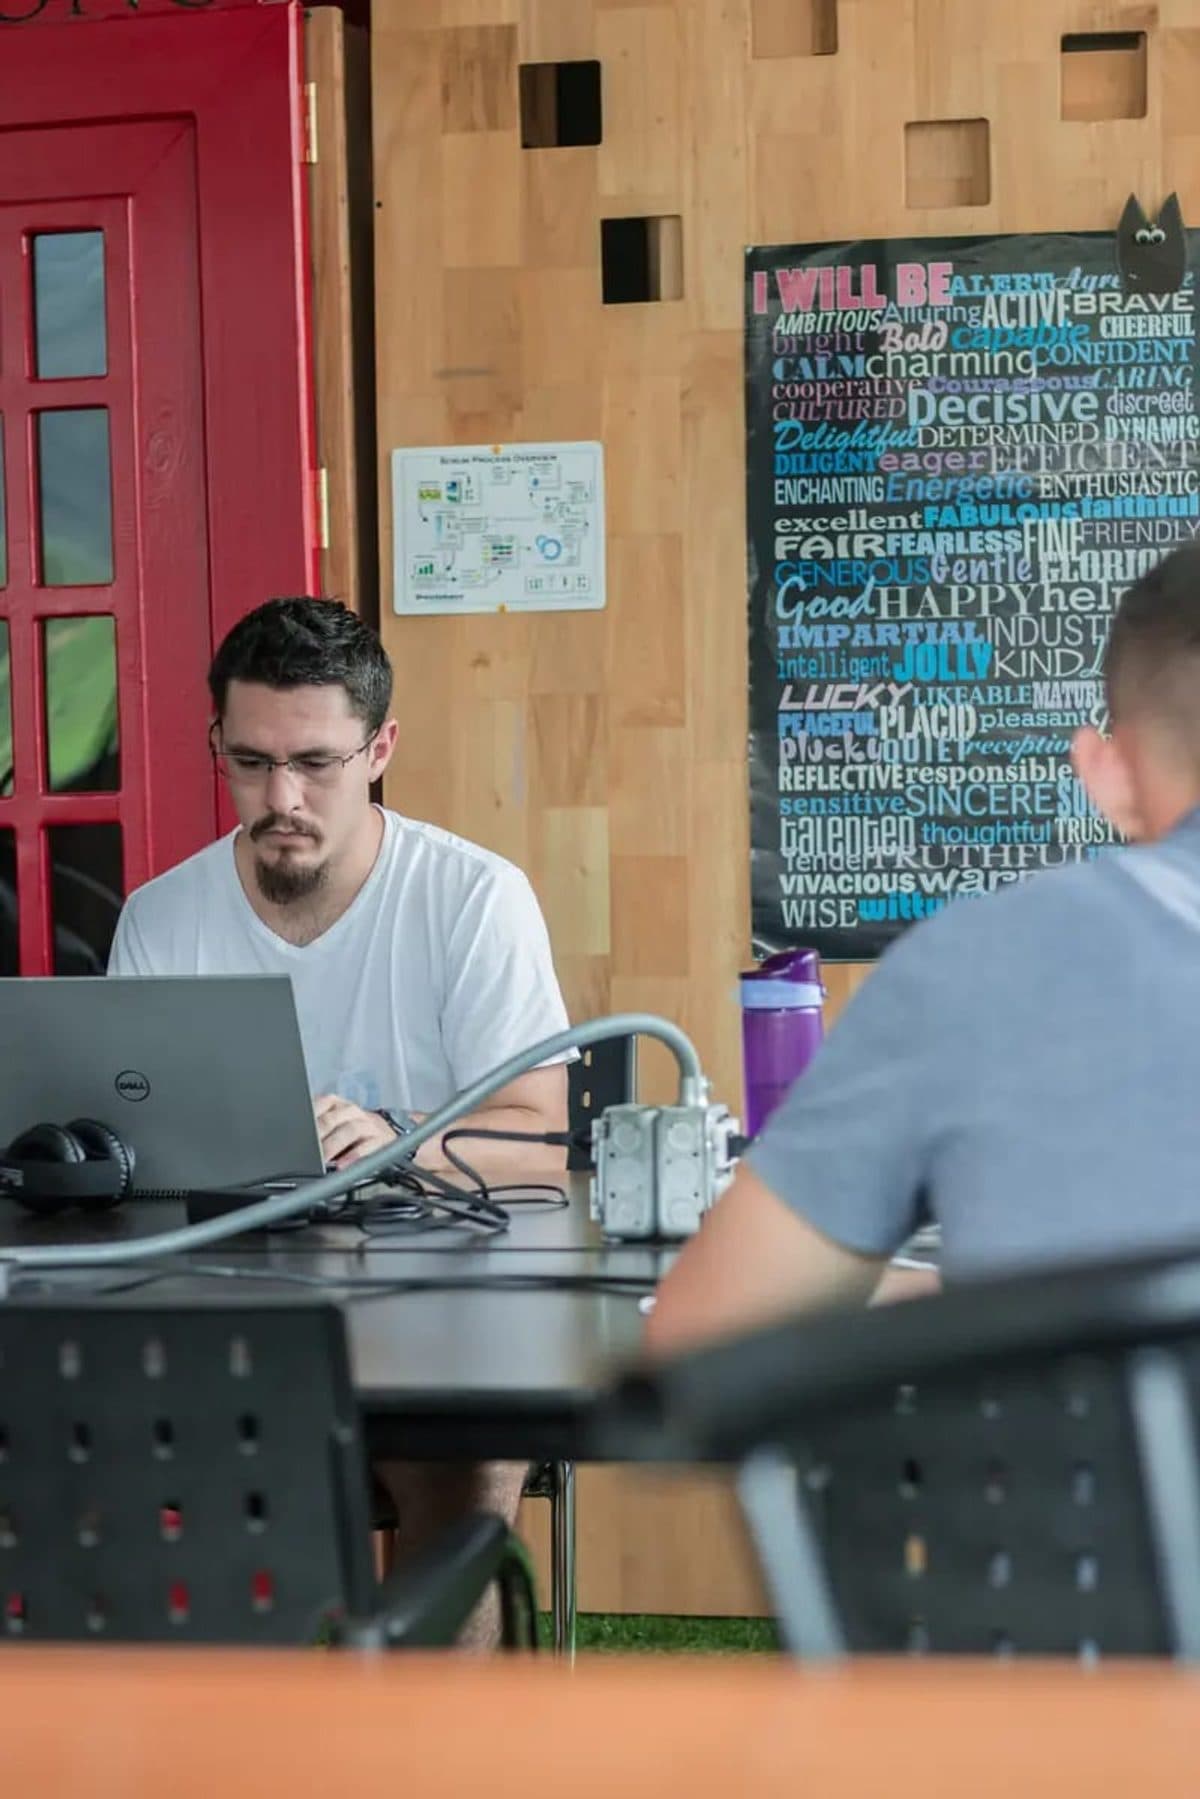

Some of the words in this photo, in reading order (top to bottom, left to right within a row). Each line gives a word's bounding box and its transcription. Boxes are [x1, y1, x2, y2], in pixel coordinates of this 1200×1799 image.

[753, 271, 769, 314] I
[776, 264, 887, 313] WILL
[896, 262, 954, 307] BE
[949, 272, 1056, 296] ALERT
[775, 310, 884, 335] AMBITIOUS
[882, 302, 983, 329] Alluring
[982, 289, 1073, 329] ACTIVE
[1073, 290, 1196, 315] BRAVE
[772, 326, 865, 358] bright
[877, 320, 949, 353] Bold
[951, 318, 1091, 355] capable
[1100, 313, 1196, 339] CHEERFUL
[772, 354, 866, 380] CALM
[865, 347, 1037, 380] charming
[1031, 339, 1196, 366] CONFIDENT
[772, 377, 922, 406] cooperative
[1092, 365, 1195, 389] CARING
[773, 397, 907, 421] CULTURED
[908, 389, 1099, 426] Decisive
[1106, 386, 1195, 415] discreet
[774, 419, 919, 457] Delightful
[917, 422, 1100, 448] DETERMINED
[1104, 415, 1200, 441] DYNAMIC
[774, 451, 877, 476] DILIGENT
[878, 450, 987, 477] eager
[989, 441, 1198, 474] EFFICIENT
[775, 476, 885, 505] ENCHANTING
[886, 470, 1033, 506] Energetic
[1039, 470, 1199, 498] ENTHUSIASTIC
[774, 509, 923, 532] excellent
[924, 501, 1079, 528] FABULOUS
[1079, 495, 1200, 518] faithful
[774, 534, 887, 560] FAIR
[886, 529, 1023, 556] FEARLESS
[1022, 518, 1083, 562] FINE
[1080, 519, 1200, 544] FRIENDLY
[773, 557, 931, 587] GENEROUS
[930, 551, 1033, 584] Gentle
[1040, 547, 1172, 582] GLORIO
[776, 575, 876, 633] Good
[875, 582, 1039, 620] HAPPY
[778, 621, 985, 649] IMPARTIAL
[777, 649, 891, 685] intelligent
[892, 641, 993, 682] JOLLY
[994, 647, 1085, 678] KIND
[778, 682, 914, 712] LUCKY
[912, 685, 1032, 707] LIKEABLE
[777, 710, 880, 737] PEACEFUL
[879, 703, 977, 741] PLACID
[978, 708, 1088, 733] pleasant
[880, 737, 967, 763] QUIET
[965, 734, 1076, 763] receptiv
[778, 764, 904, 791] REFLECTIVE
[905, 757, 1073, 790] responsible
[779, 791, 906, 816] sensitive
[906, 783, 1055, 817] SINCERE
[921, 819, 1050, 848] thoughtful
[917, 867, 1040, 894] war
[780, 898, 859, 928] WISE
